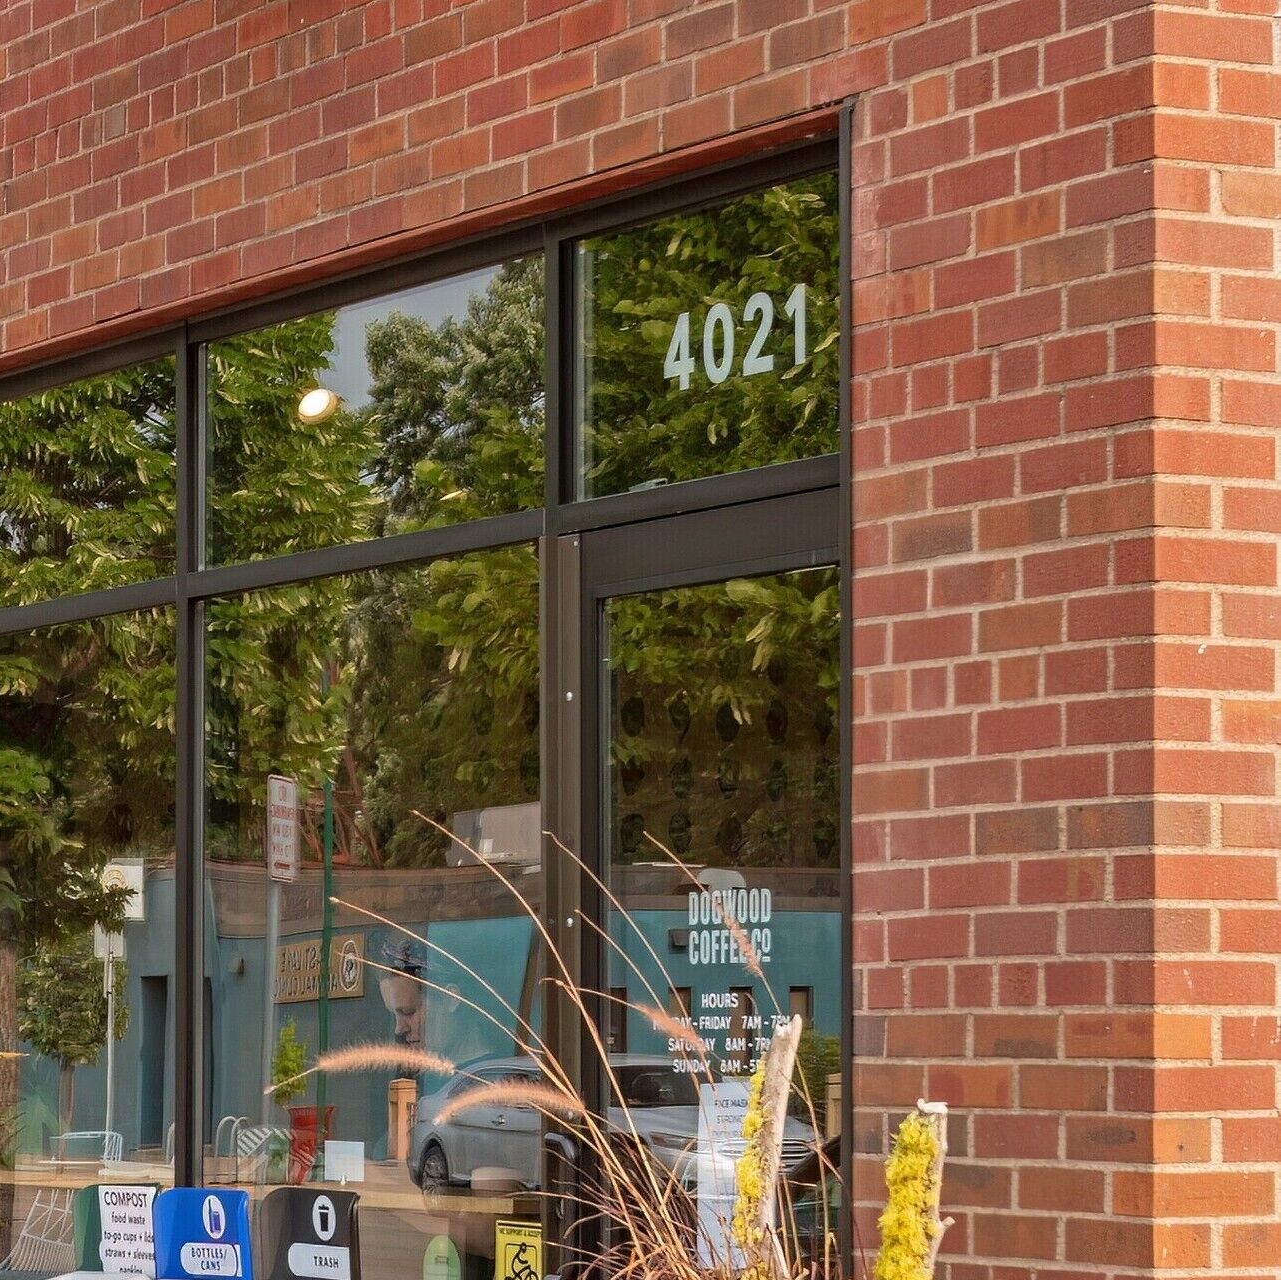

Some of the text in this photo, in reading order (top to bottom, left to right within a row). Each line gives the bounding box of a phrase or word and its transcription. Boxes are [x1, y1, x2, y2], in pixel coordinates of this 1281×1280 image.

[663, 282, 807, 391] 4021
[688, 888, 772, 926] DOGWOOD
[701, 993, 739, 1009] HOURS
[699, 1016, 732, 1030] FRIDAY
[742, 1015, 762, 1030] 7AM
[672, 1058, 711, 1073] SUNDAY
[103, 1191, 148, 1208] COMPOST
[111, 1211, 146, 1225] food waste
[104, 1230, 121, 1243] to-go
[123, 1233, 137, 1244] cups
[104, 1248, 126, 1259] straws
[200, 1259, 221, 1271] CANS
[313, 1255, 340, 1269] TRASH
